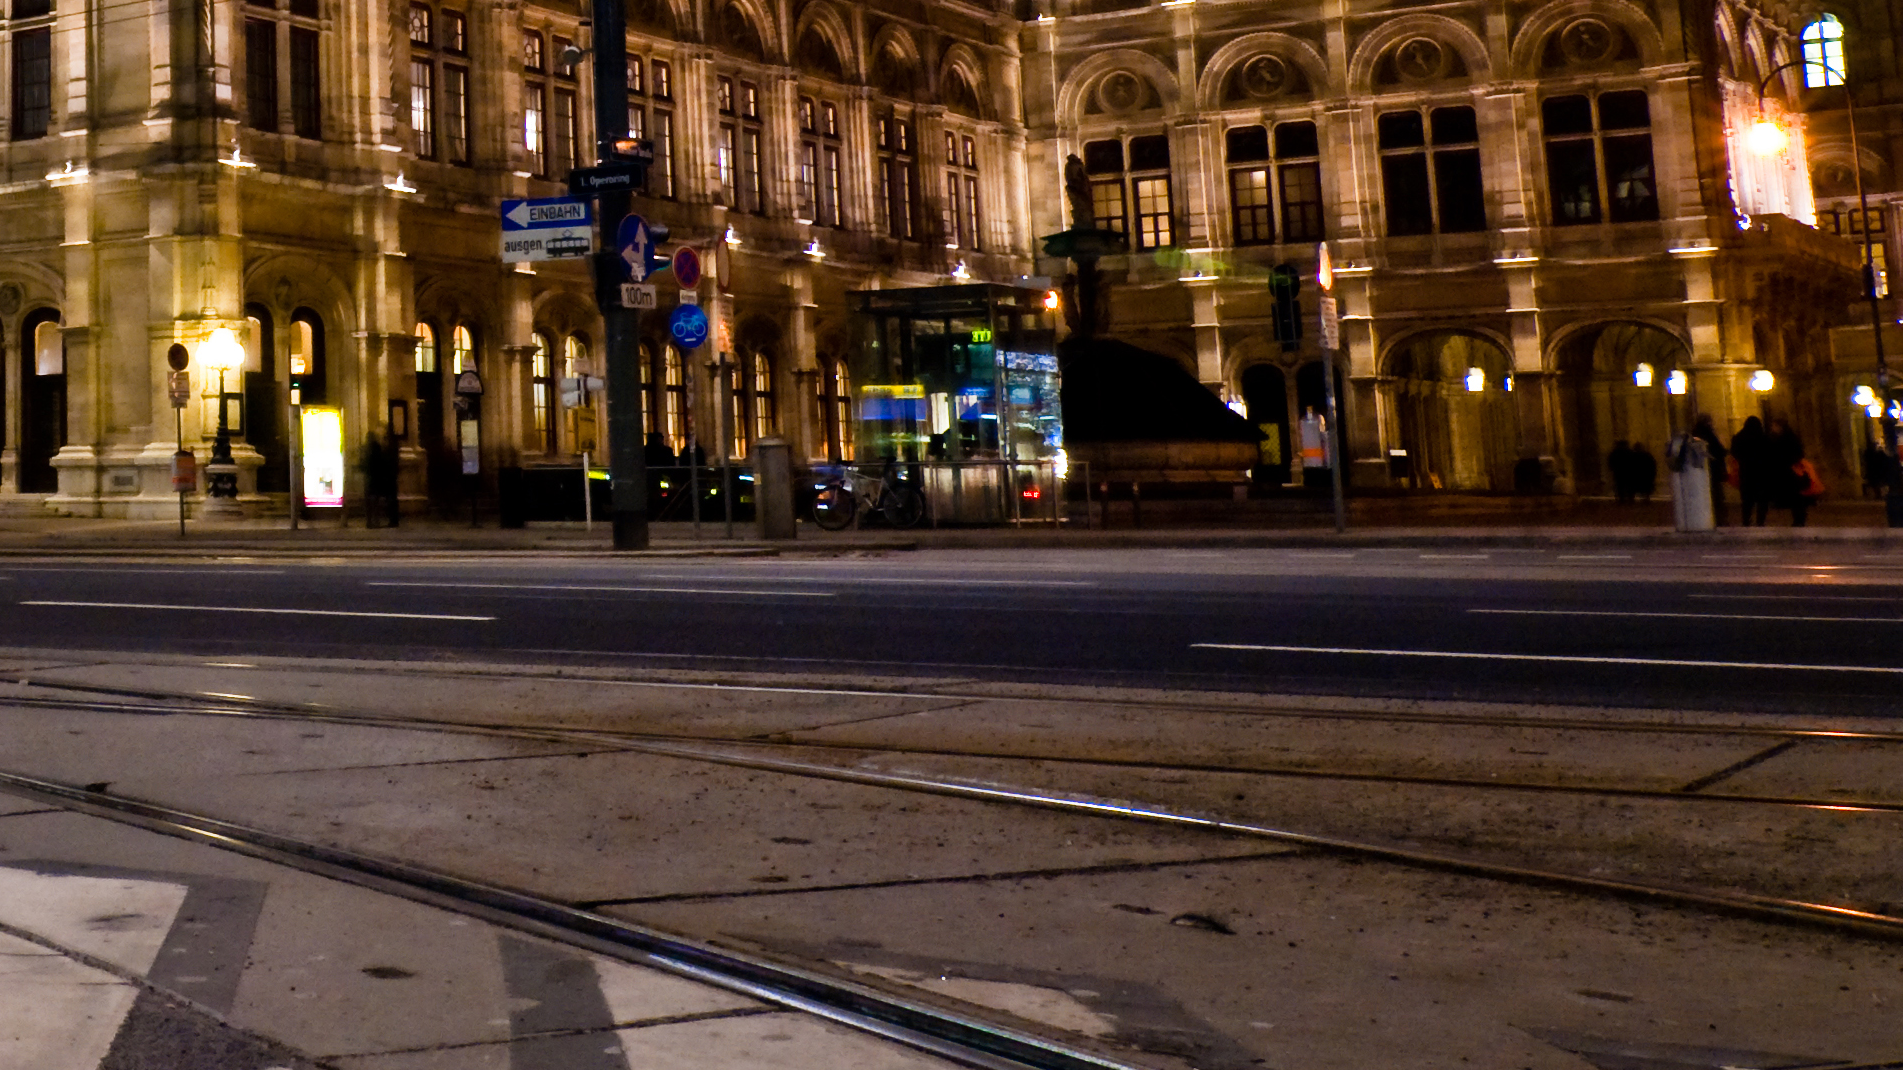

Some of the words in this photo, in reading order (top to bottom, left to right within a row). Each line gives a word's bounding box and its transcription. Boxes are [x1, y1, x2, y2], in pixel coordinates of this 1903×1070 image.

[589, 173, 630, 188] Opernring
[529, 205, 581, 221] EINBAHN
[625, 286, 652, 305] 100m
